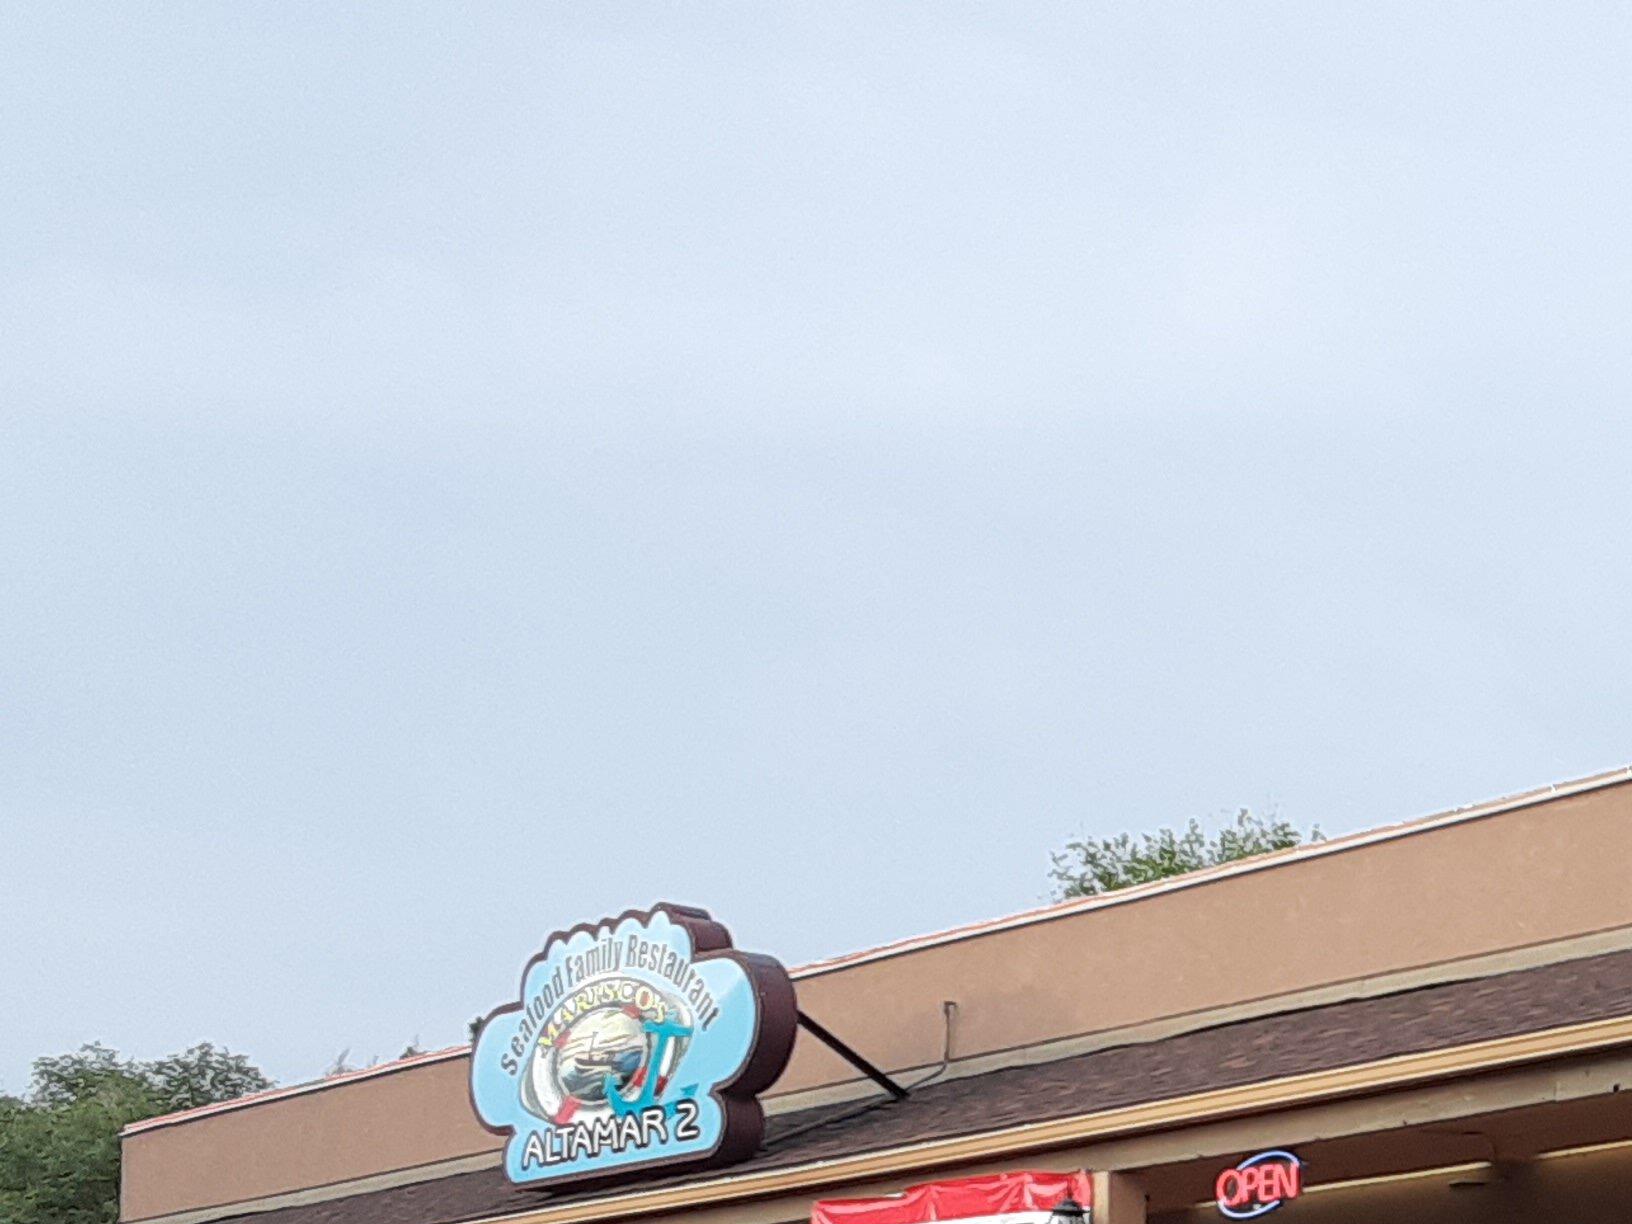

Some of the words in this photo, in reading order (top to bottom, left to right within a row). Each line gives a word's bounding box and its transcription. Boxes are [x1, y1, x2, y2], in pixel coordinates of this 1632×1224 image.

[500, 965, 564, 1077] Seafood
[565, 937, 623, 987] Family
[624, 934, 720, 1032] Restaurant
[522, 1107, 668, 1170] ALTAMAR
[675, 1099, 701, 1141] 2
[1216, 1162, 1299, 1206] OPEN
